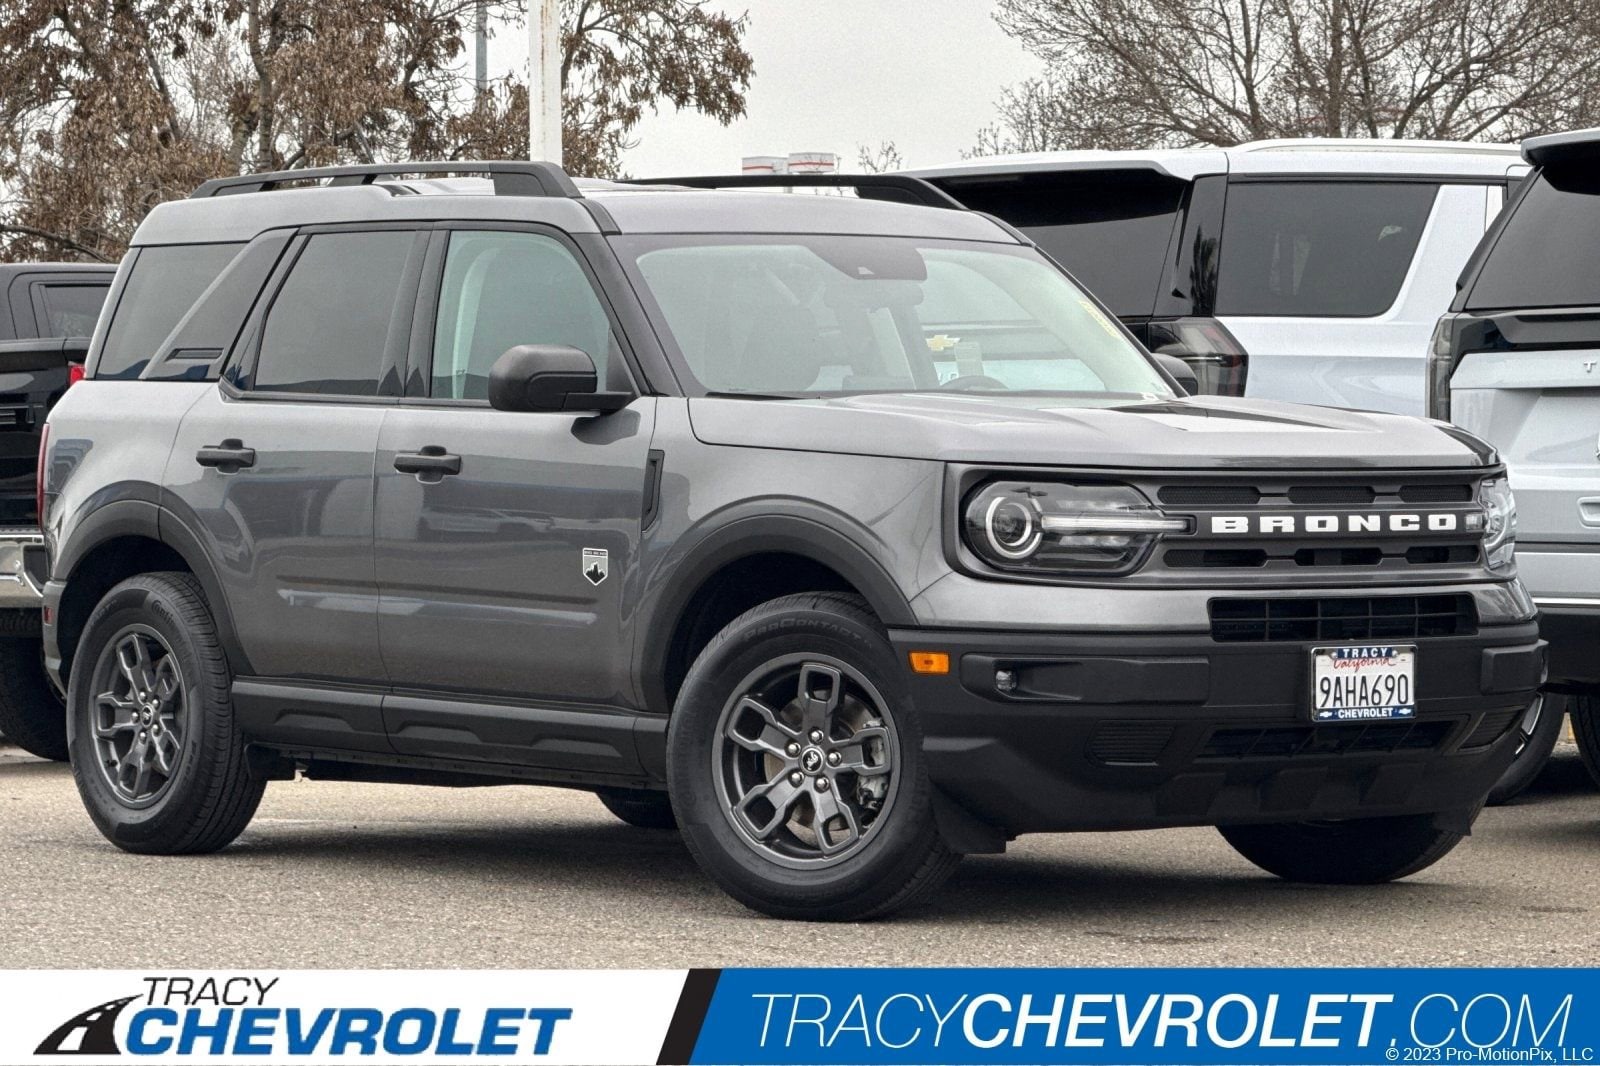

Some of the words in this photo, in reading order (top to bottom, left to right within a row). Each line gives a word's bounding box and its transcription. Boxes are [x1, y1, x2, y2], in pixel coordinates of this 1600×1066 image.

[1211, 513, 1457, 534] BRONCO
[1343, 647, 1388, 659] TRACY
[1333, 657, 1397, 673] California
[1319, 673, 1409, 708] 9AHA690
[1337, 707, 1394, 719] CHEVROLET
